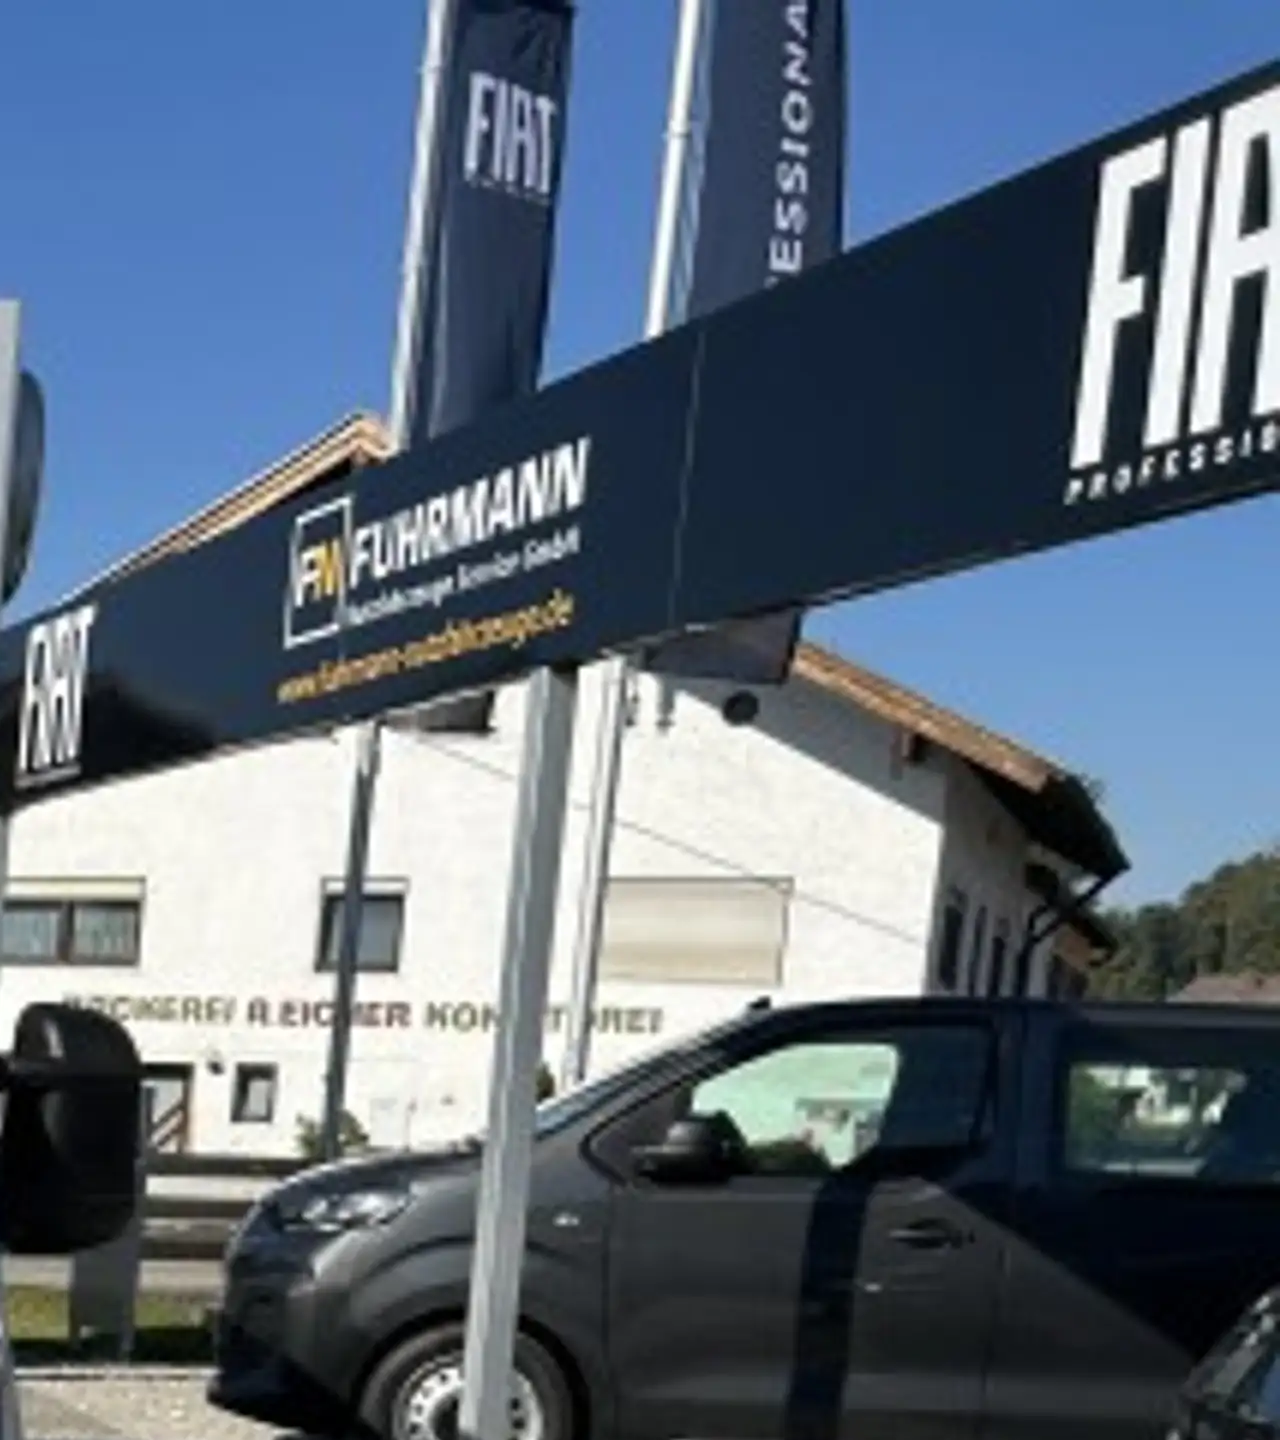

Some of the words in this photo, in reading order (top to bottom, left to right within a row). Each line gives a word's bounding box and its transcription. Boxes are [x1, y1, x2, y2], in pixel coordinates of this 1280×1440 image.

[463, 70, 558, 195] FIAT
[764, 0, 813, 288] ESSIONA
[349, 436, 591, 590] FUHRMANN
[17, 603, 98, 774] FIAT
